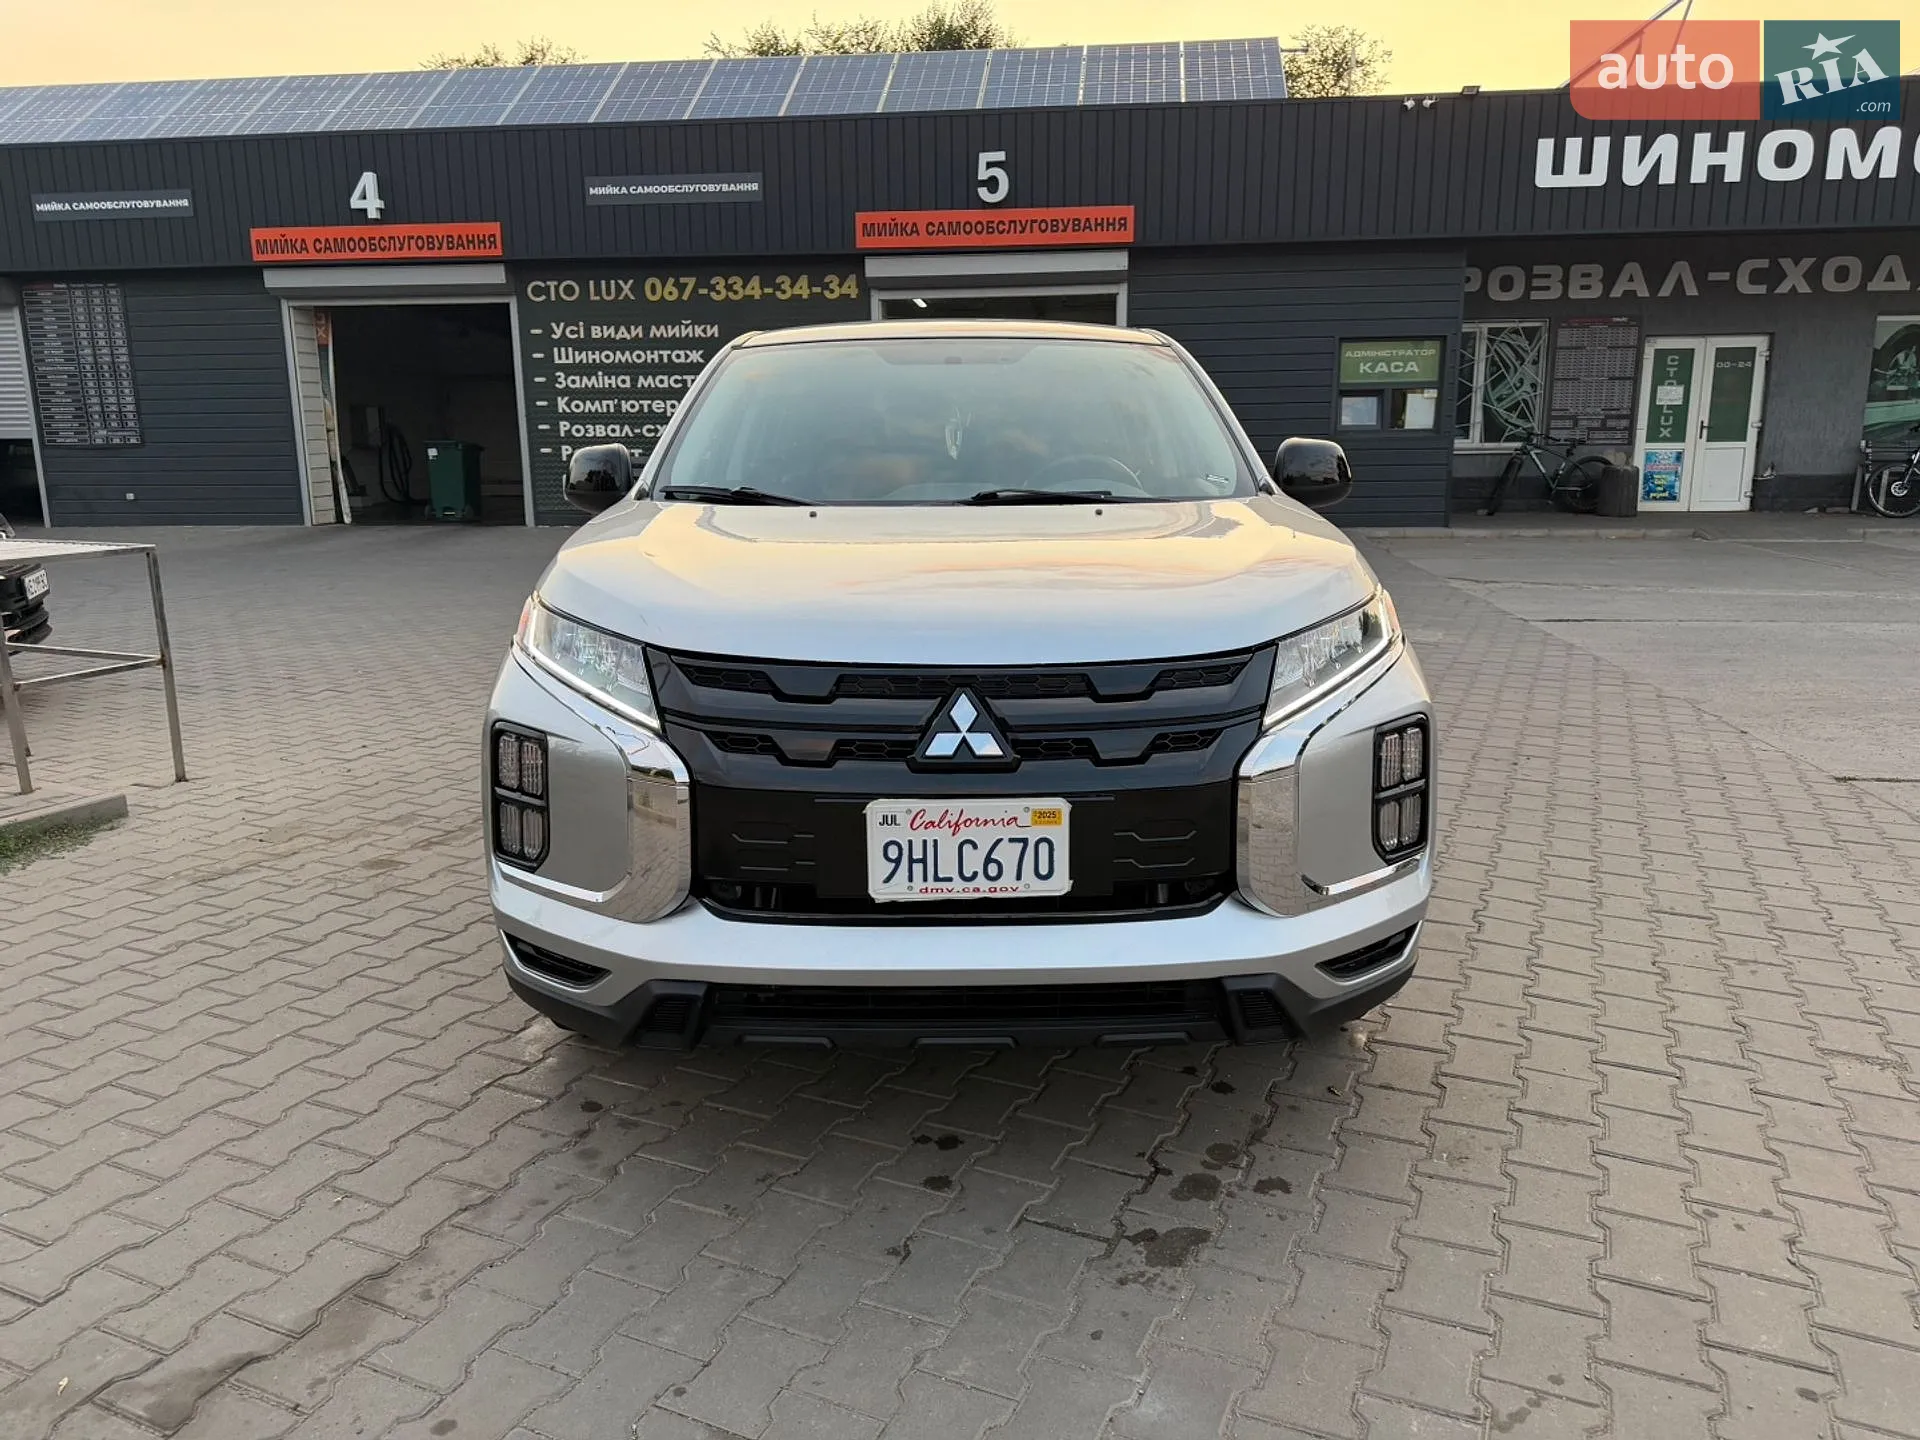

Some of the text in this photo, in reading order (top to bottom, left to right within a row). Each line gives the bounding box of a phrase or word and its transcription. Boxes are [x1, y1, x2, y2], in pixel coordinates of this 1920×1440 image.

[1535, 126, 1920, 188] ШИНОМ
[977, 150, 1009, 203] 5
[350, 172, 385, 219] 4
[589, 183, 759, 195] МИЙКА САМООБСЛУГОВУВАННЯ
[36, 199, 189, 212] МИЙКА САМООБСЛУГОВУВАННЯ
[862, 217, 1128, 237] МИЙКА САМООБСЛУГОВУВАННЯ
[255, 232, 498, 255] МИЙКА САМООБСЛУГОВУВАННЯ
[1464, 254, 1920, 301] ОЗВАЛ-СХОД
[526, 274, 859, 302] СТО LUX 067-334-34-34
[551, 319, 720, 340] Усі види мийки
[553, 347, 705, 364] Шиномонтаж
[1345, 349, 1437, 358] АДМІНІСТРАТОР
[1359, 361, 1420, 374] КАСА
[555, 371, 700, 389] Заміна маст
[878, 814, 901, 827] JUL
[909, 808, 1021, 836] California
[1037, 810, 1057, 819] 2025
[882, 837, 1055, 883] 9HLC670
[918, 885, 1020, 894] dmv.ca.gov
